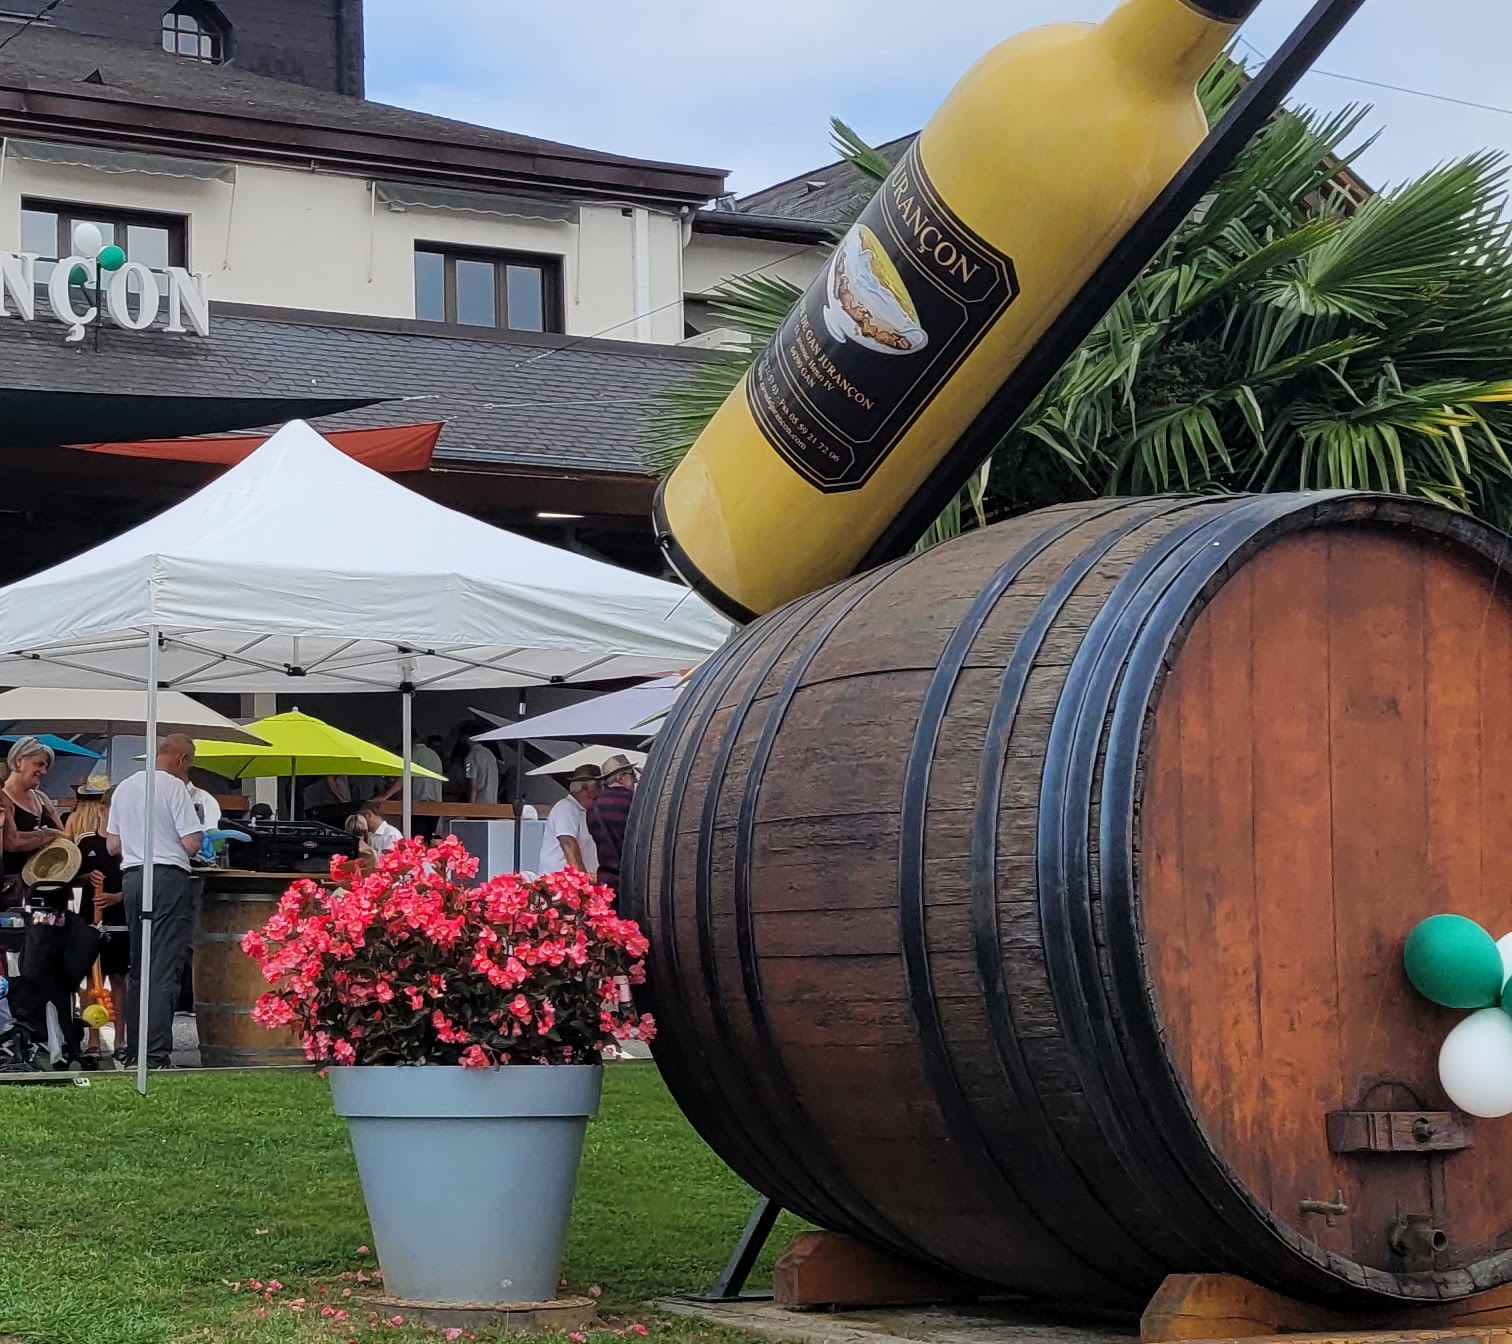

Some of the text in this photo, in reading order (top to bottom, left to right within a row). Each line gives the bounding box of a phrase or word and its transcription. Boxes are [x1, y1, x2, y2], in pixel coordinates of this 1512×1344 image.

[800, 367, 817, 388] GAN
[805, 329, 822, 356] GAN
[818, 353, 875, 410] JURANÇON
[823, 379, 835, 391] IV
[807, 430, 818, 444] 21
[817, 441, 829, 454] 72
